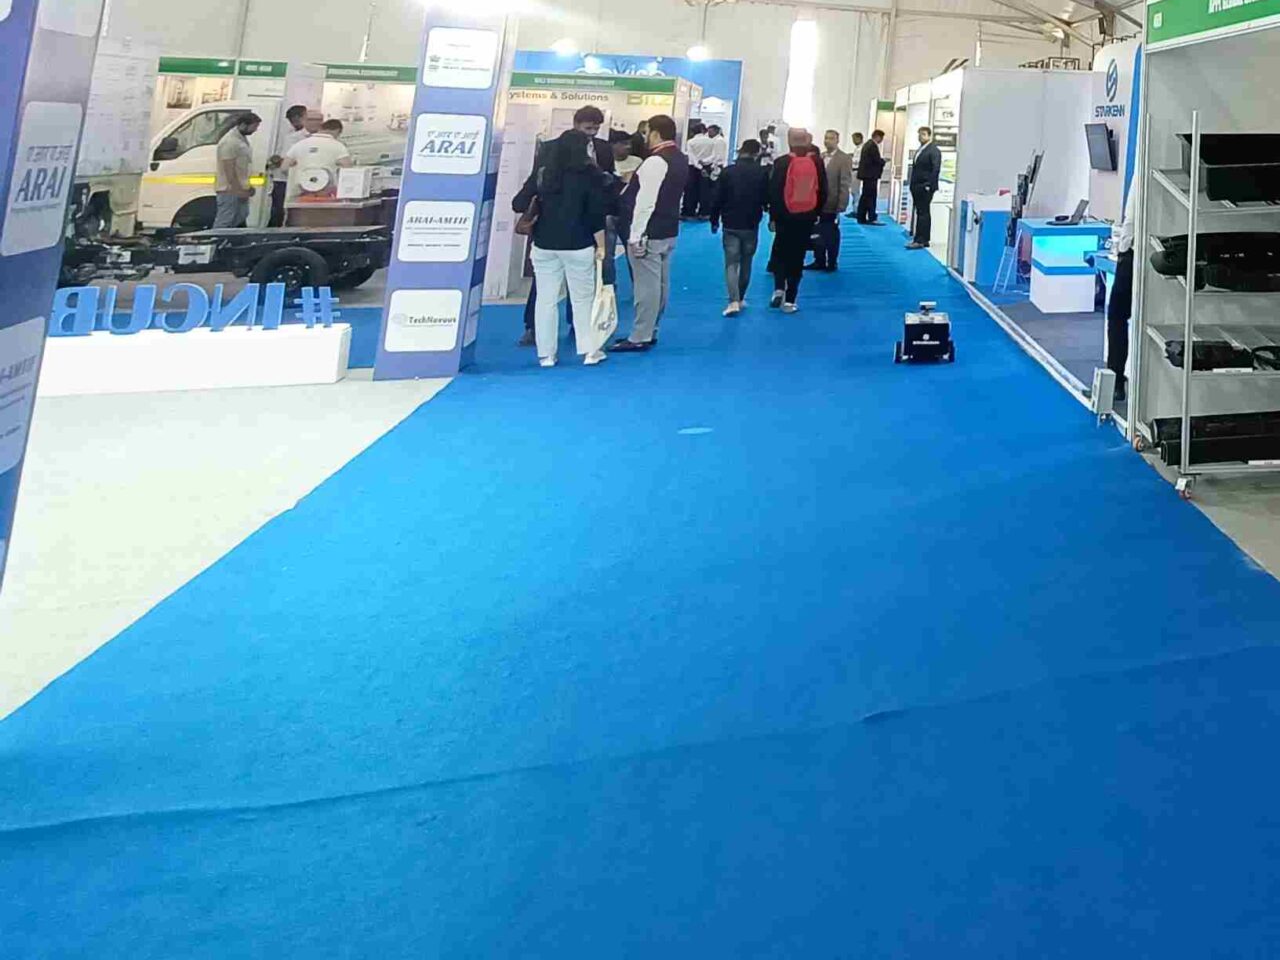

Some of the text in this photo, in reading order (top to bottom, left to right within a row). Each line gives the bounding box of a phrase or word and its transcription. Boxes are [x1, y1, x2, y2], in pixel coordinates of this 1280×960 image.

[550, 92, 557, 100] &
[560, 92, 609, 102] Solutions
[420, 140, 476, 154] ARAI
[14, 166, 68, 203] ARAI
